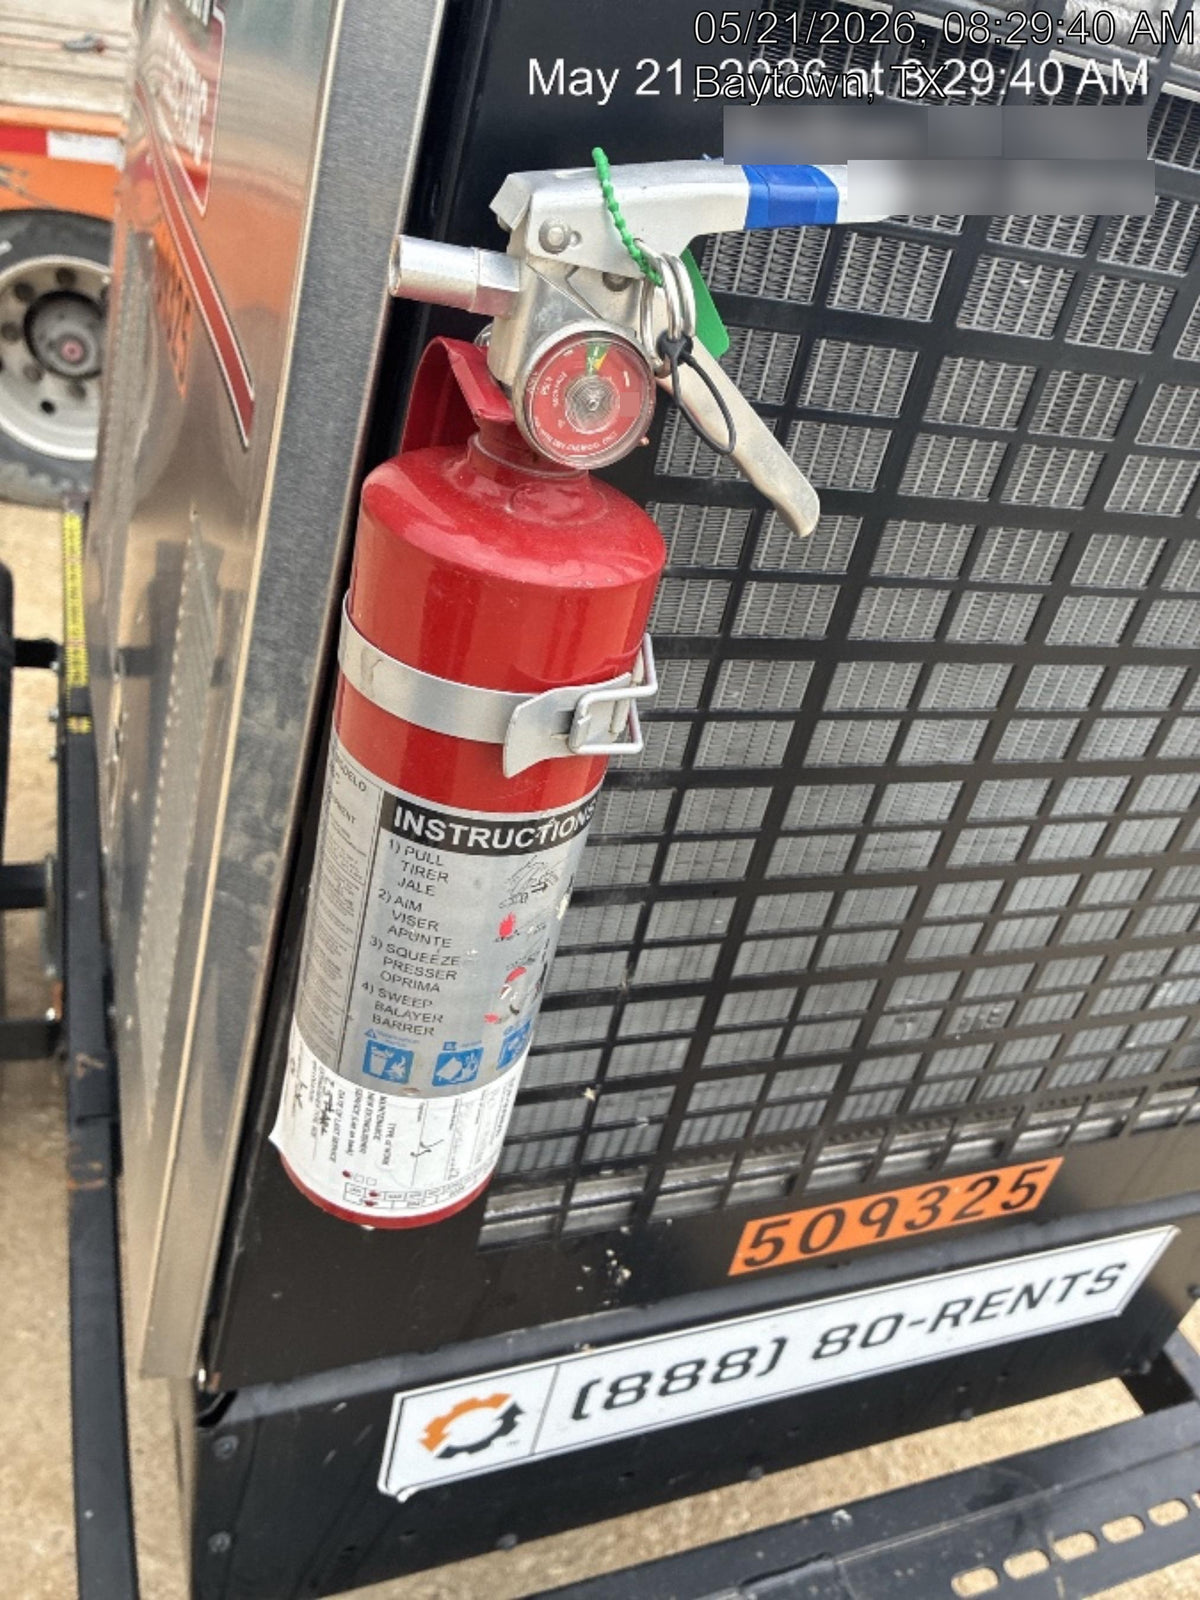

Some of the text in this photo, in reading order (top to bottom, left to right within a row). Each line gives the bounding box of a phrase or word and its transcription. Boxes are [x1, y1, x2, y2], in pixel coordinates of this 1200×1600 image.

[389, 838, 445, 867] 1) PULL
[401, 859, 449, 884] TIRER
[397, 876, 436, 897] JALE
[378, 888, 423, 914] 2) AIM
[392, 910, 439, 932] VISER
[387, 925, 452, 948] APUNTE
[369, 935, 460, 966] 3) SQUEEZE
[380, 970, 440, 992] OPRIMA
[383, 956, 457, 981] PRESSER
[361, 981, 433, 1009] 4) SWEEP
[374, 1000, 444, 1023] BALAYER
[372, 1013, 435, 1036] BARRER
[744, 1165, 1048, 1267] 509325
[573, 1260, 1128, 1420] (888) 80-RENTS
